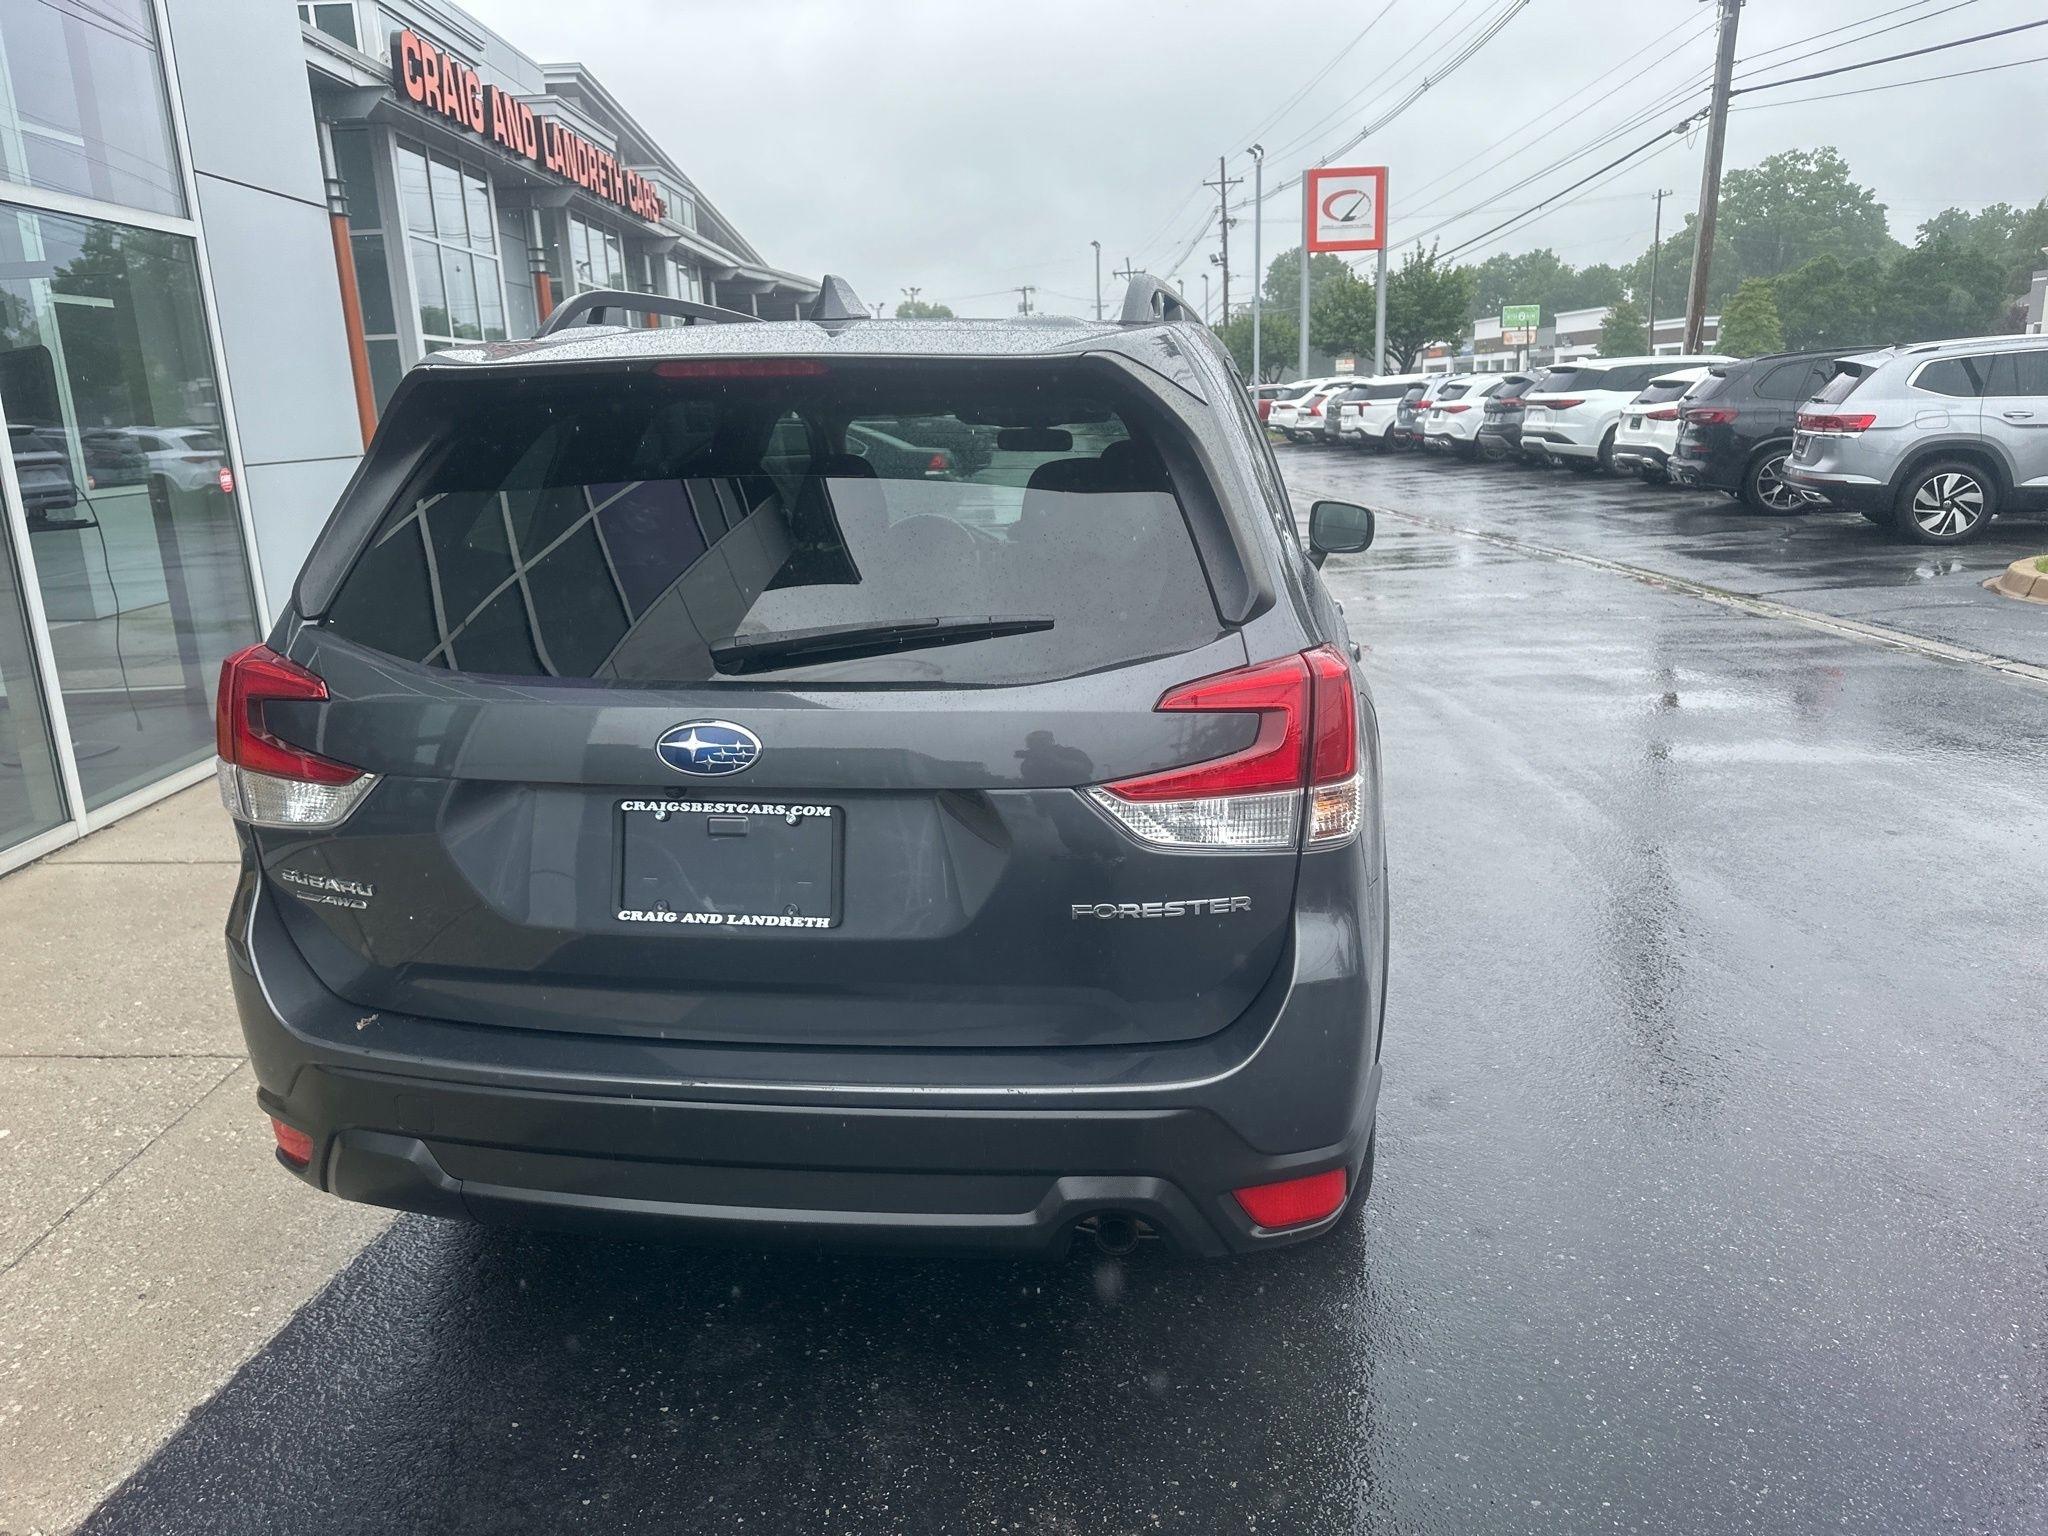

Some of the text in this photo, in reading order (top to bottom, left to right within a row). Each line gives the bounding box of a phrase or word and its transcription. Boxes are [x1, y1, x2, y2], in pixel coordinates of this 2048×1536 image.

[400, 28, 660, 223] CRAIG AND LANDRETH CARS
[620, 800, 832, 817] CRAIGSBESTCARS.COM
[281, 869, 375, 897] SUBARU
[319, 895, 368, 910] AWD
[1071, 896, 1252, 920] FORESTER
[617, 910, 831, 928] CRAIG AND LANDRETH
